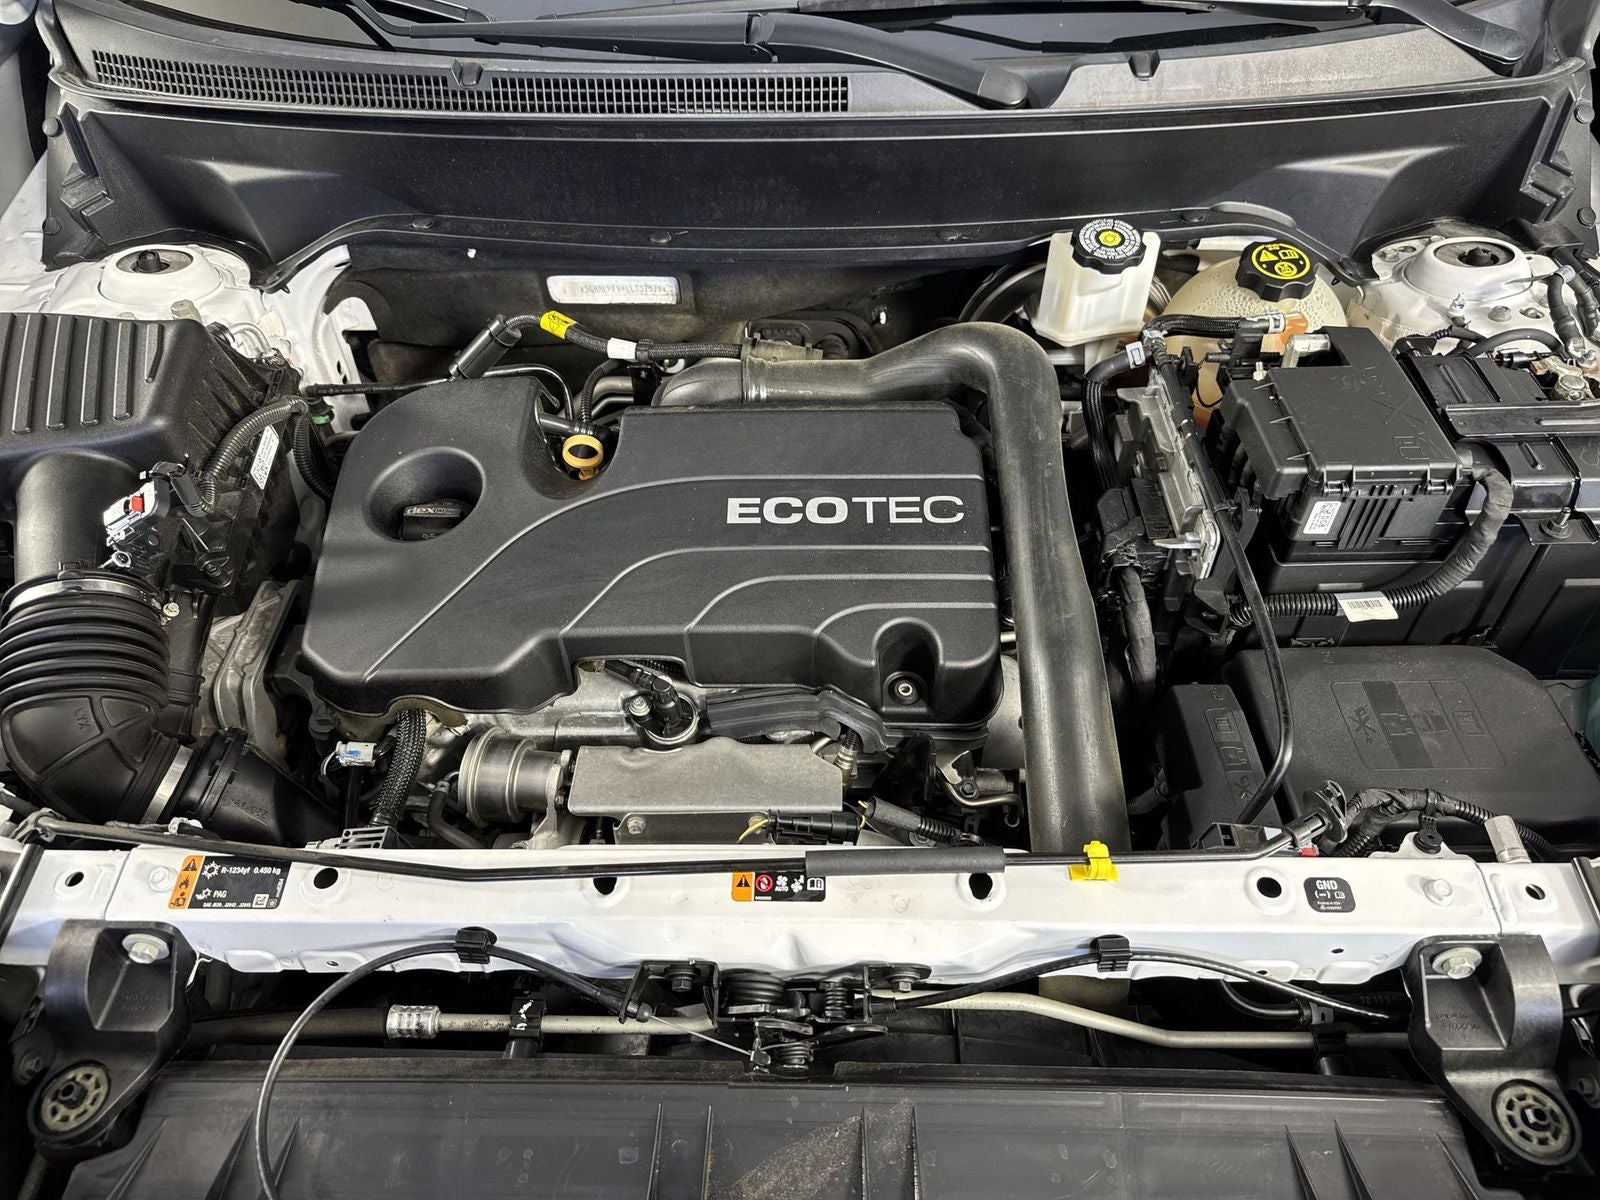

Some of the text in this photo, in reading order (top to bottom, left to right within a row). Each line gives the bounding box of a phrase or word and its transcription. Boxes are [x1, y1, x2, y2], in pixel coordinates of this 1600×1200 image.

[727, 496, 965, 524] ECOTEC
[220, 866, 250, 875] R-1234yf
[272, 866, 281, 876] kg
[1316, 880, 1338, 890] GND
[212, 890, 228, 898] PAG
